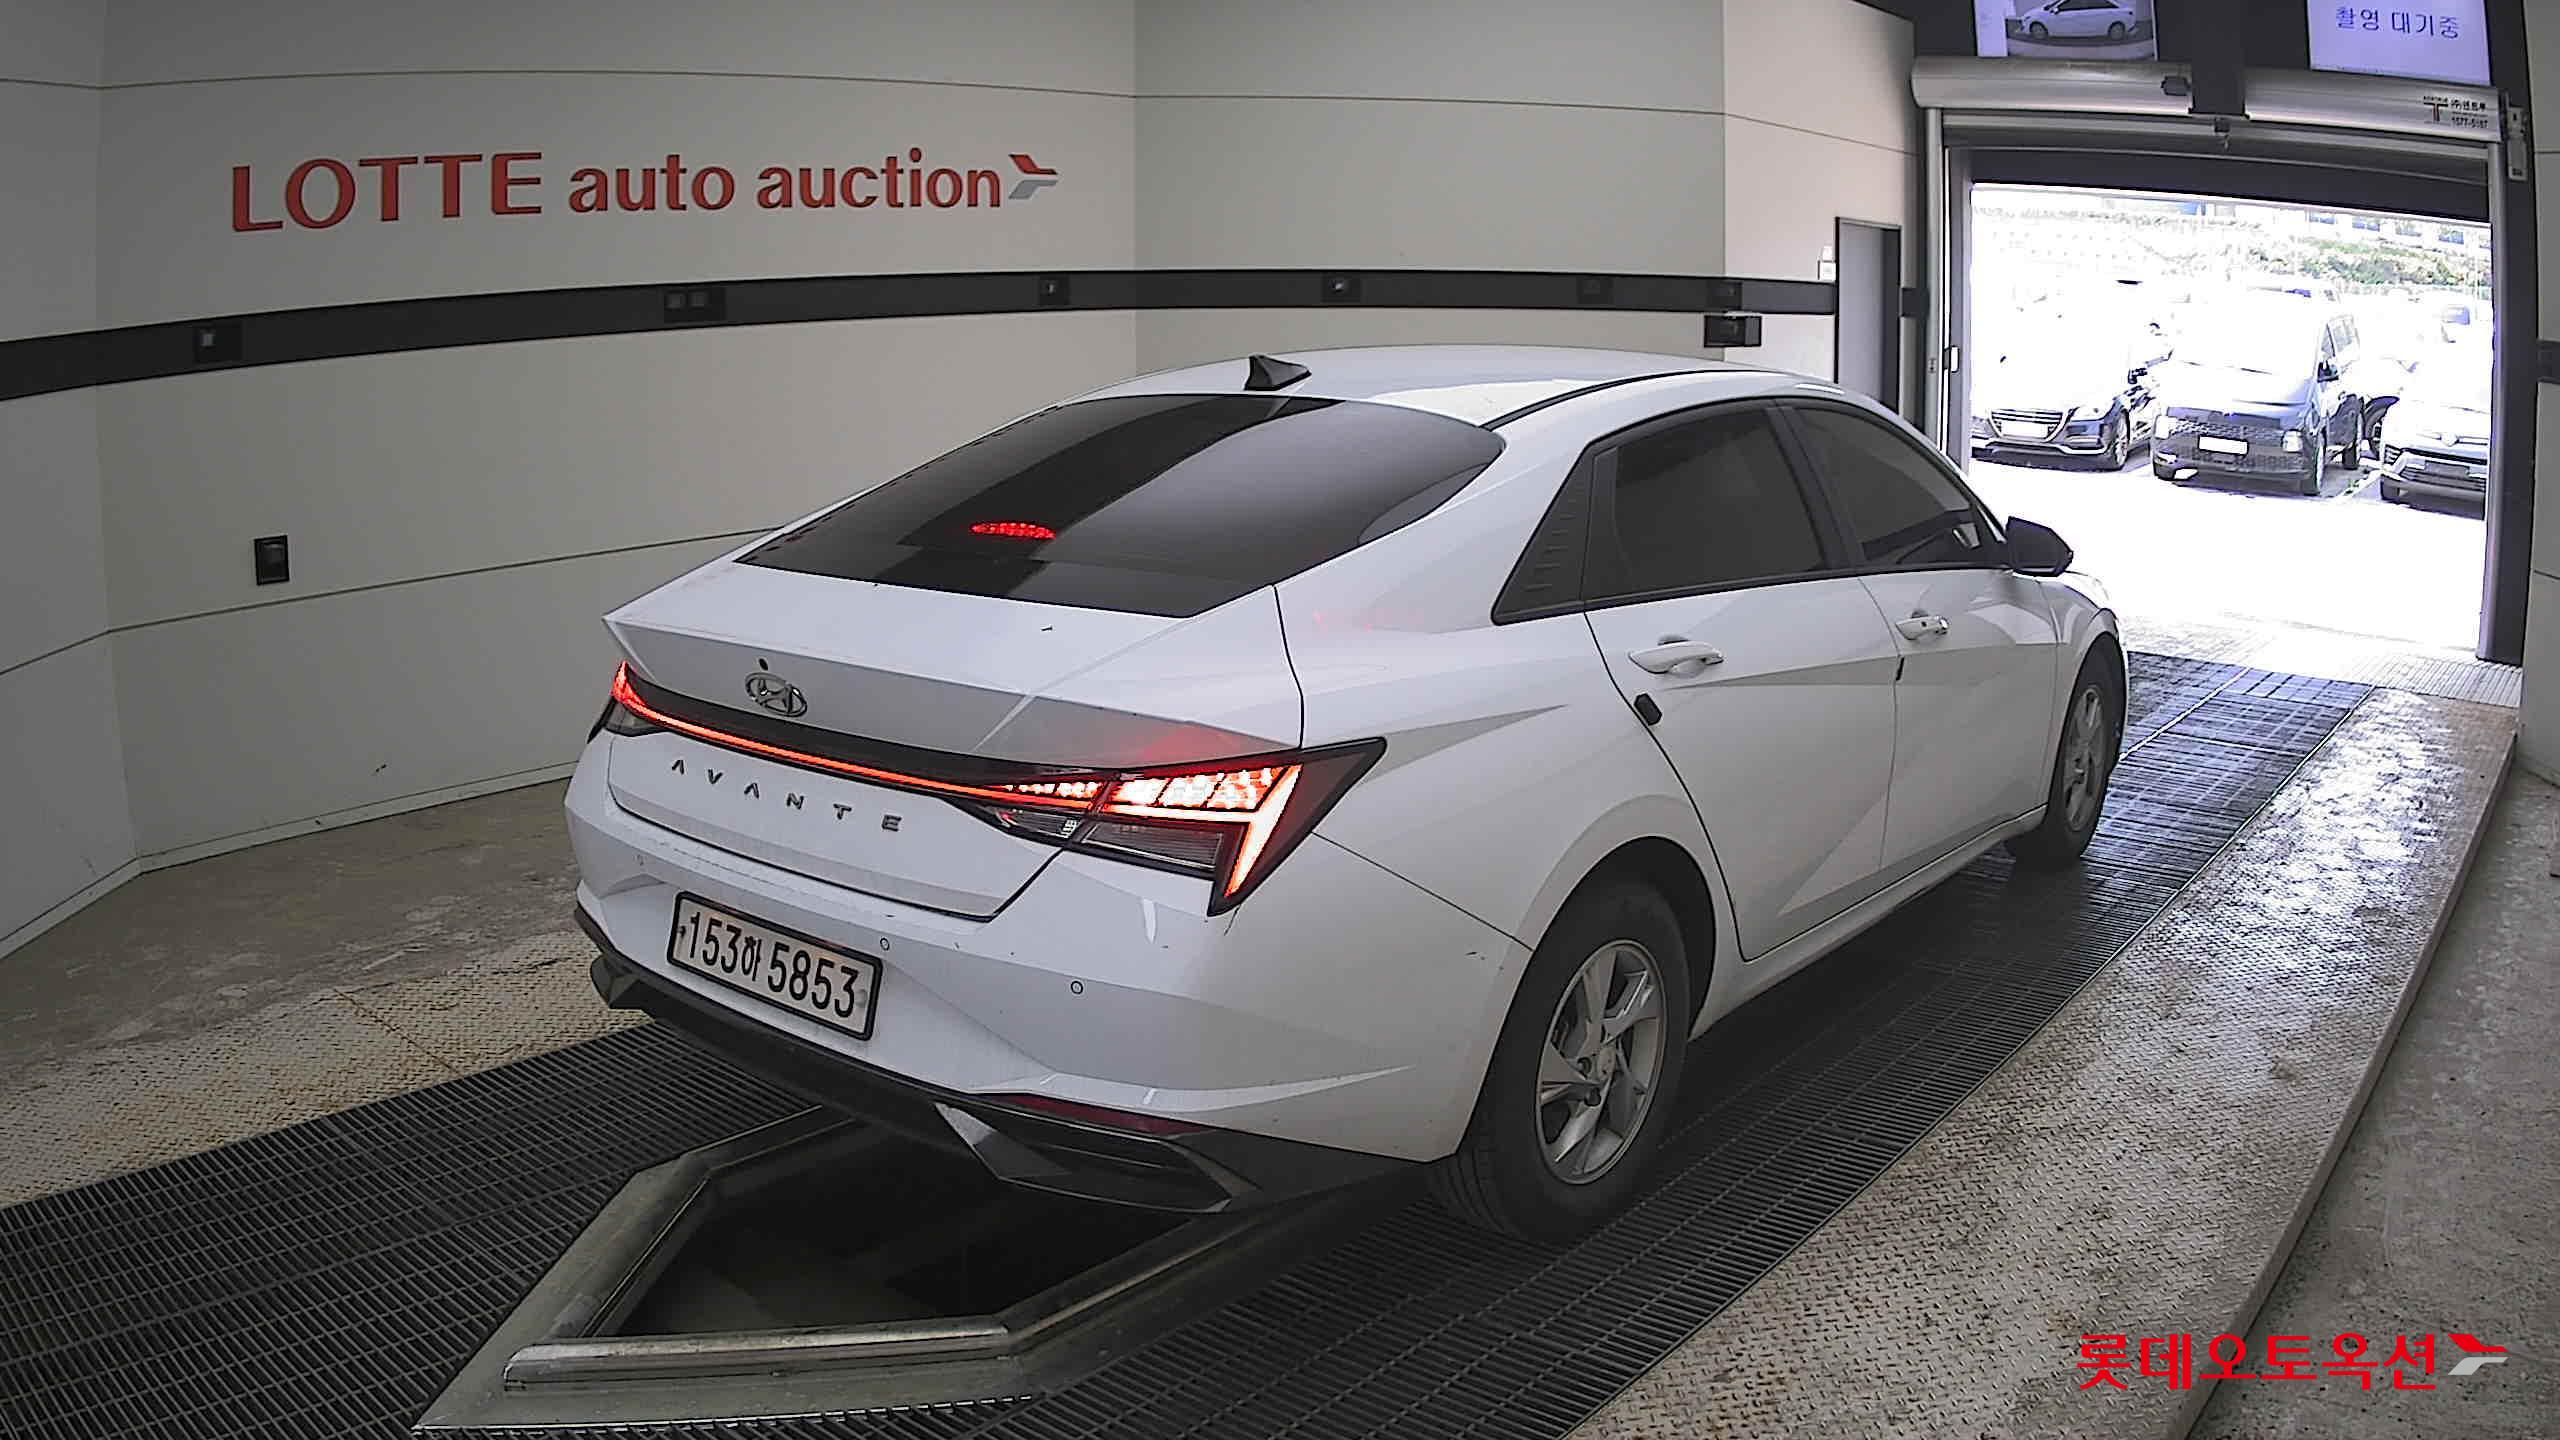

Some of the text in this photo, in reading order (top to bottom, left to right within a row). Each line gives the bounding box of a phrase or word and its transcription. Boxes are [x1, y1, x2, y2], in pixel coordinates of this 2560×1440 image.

[2336, 7, 2460, 39] 촬영 대기중
[232, 147, 1002, 232] LOTTE auto auction
[671, 759, 902, 832] AVANTE
